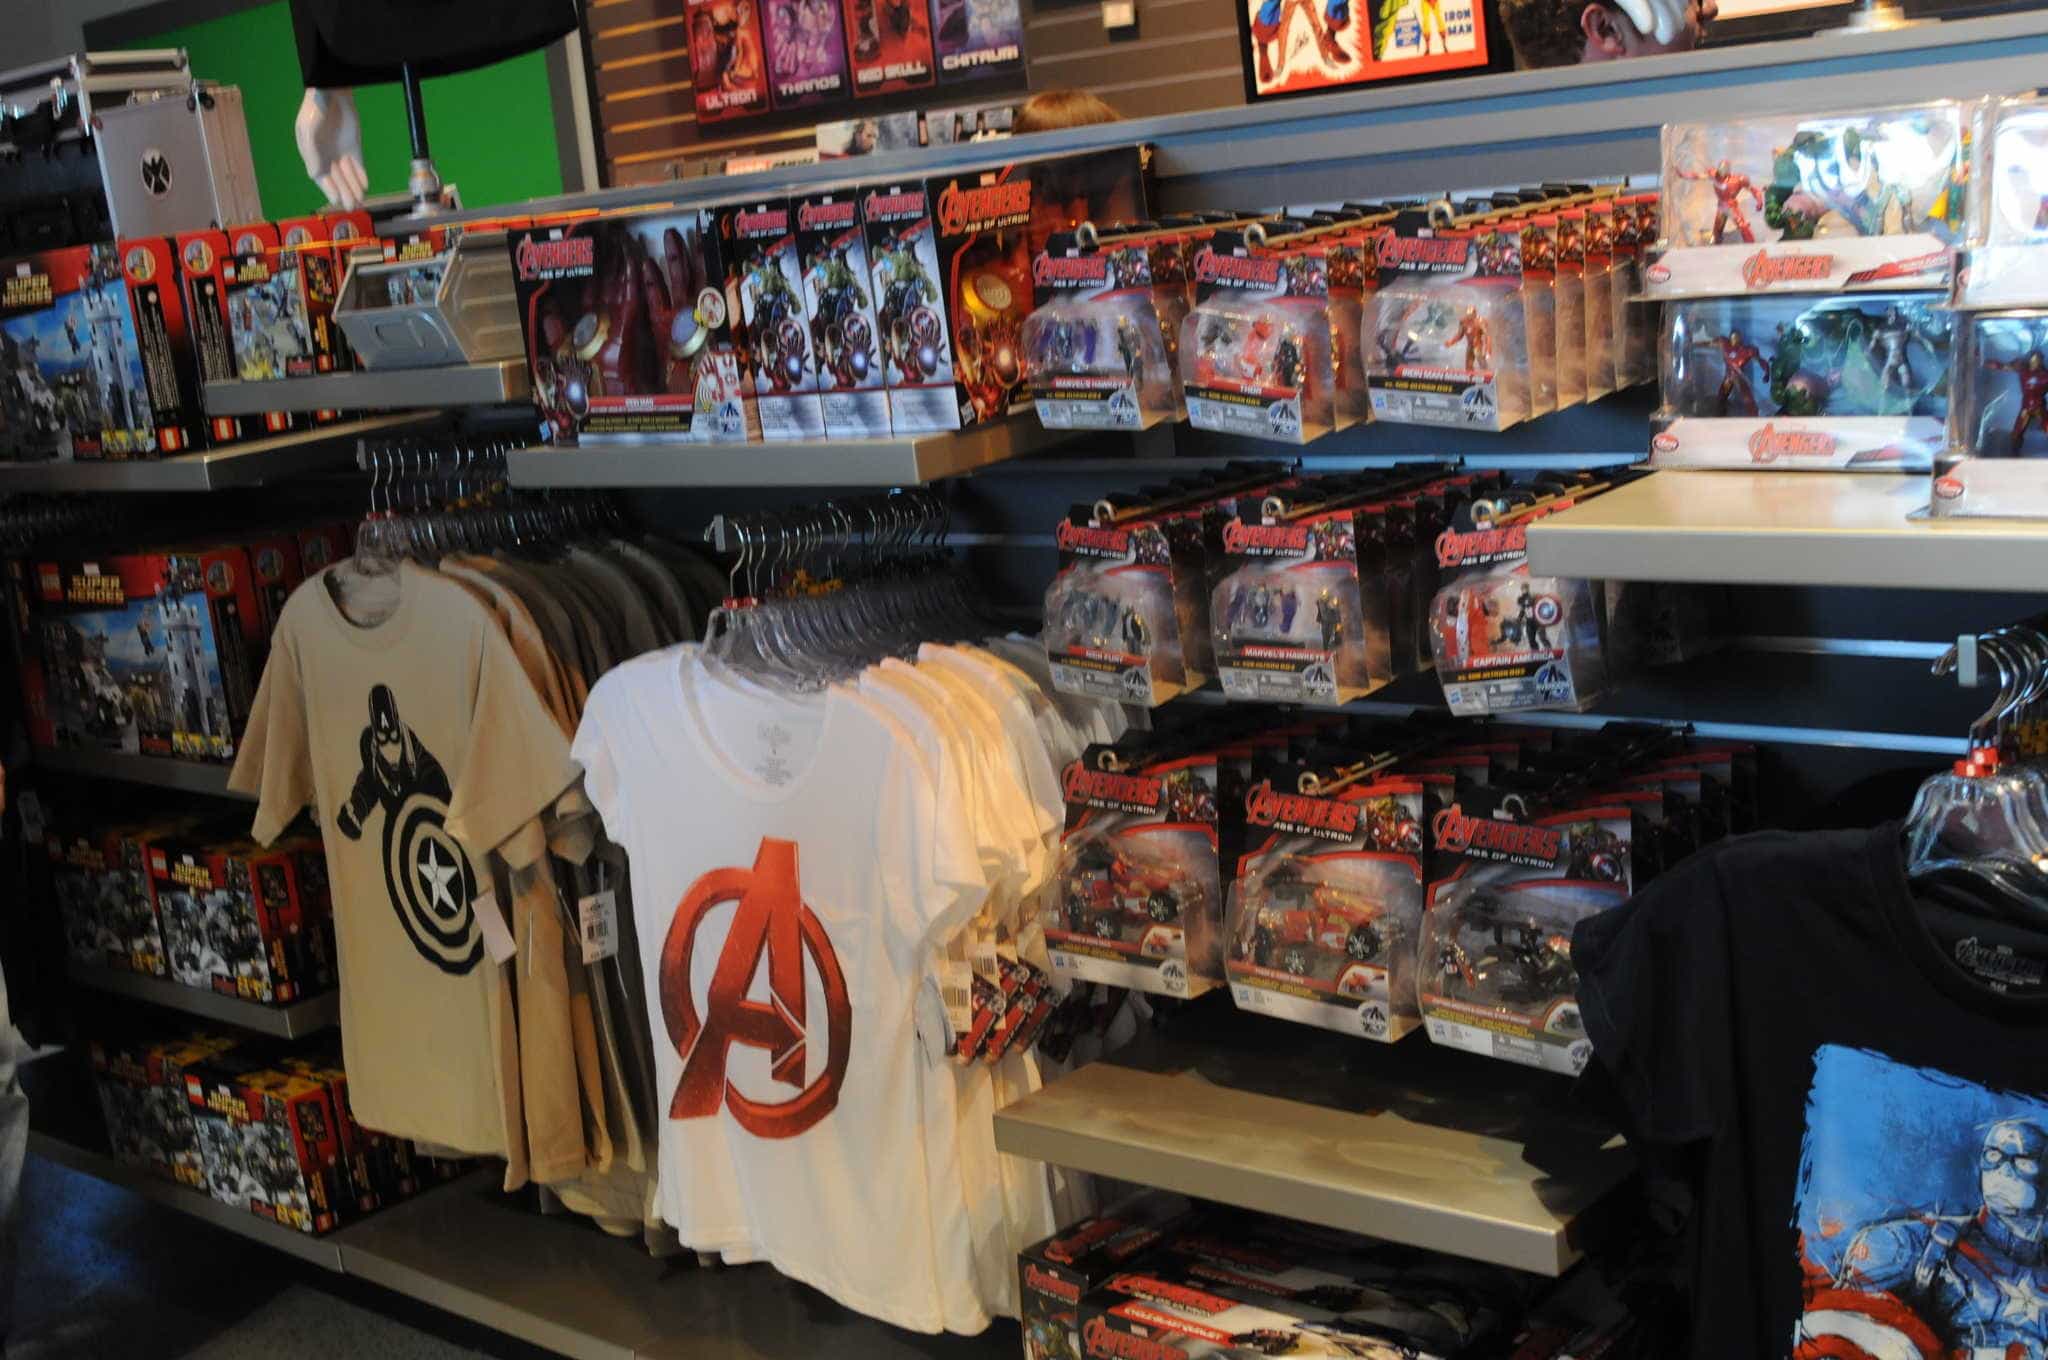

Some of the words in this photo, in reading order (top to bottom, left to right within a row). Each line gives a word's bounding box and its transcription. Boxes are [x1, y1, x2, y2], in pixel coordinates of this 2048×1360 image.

[1445, 8, 1470, 21] IRON
[1447, 24, 1472, 35] MAN
[779, 74, 840, 96] THANOS
[884, 60, 927, 80] SKULL
[704, 88, 758, 110] ULTRON
[938, 179, 1031, 237] AVENGERS
[516, 233, 593, 281] AVENGERS
[1194, 244, 1279, 283] AVENGERS
[1377, 227, 1469, 268] AVENGERS
[1033, 250, 1106, 287] AVENGERS
[1743, 249, 1833, 289] AVENGERS
[1056, 517, 1128, 551] AVENGERS
[1223, 516, 1308, 553] AVENGERS
[1435, 526, 1526, 568] AVENGERS
[67, 589, 125, 606] HEROES
[71, 575, 120, 590] SUPER
[1473, 656, 1511, 668] CAPTAIN
[1513, 651, 1555, 663] AMERICA
[1061, 759, 1163, 805] AVENGERS
[1088, 798, 1103, 809] AGE
[1106, 800, 1119, 811] OF
[1121, 803, 1156, 816] ULTRON
[1246, 778, 1360, 832] AVENGERS
[1273, 822, 1294, 832] AGE
[1297, 825, 1310, 835] OF
[1313, 828, 1352, 842] ULTRON
[1432, 802, 1561, 858] AVENGERS
[1465, 849, 1488, 859] AGE
[1491, 852, 1507, 862] OF
[1510, 855, 1554, 869] ULTRON
